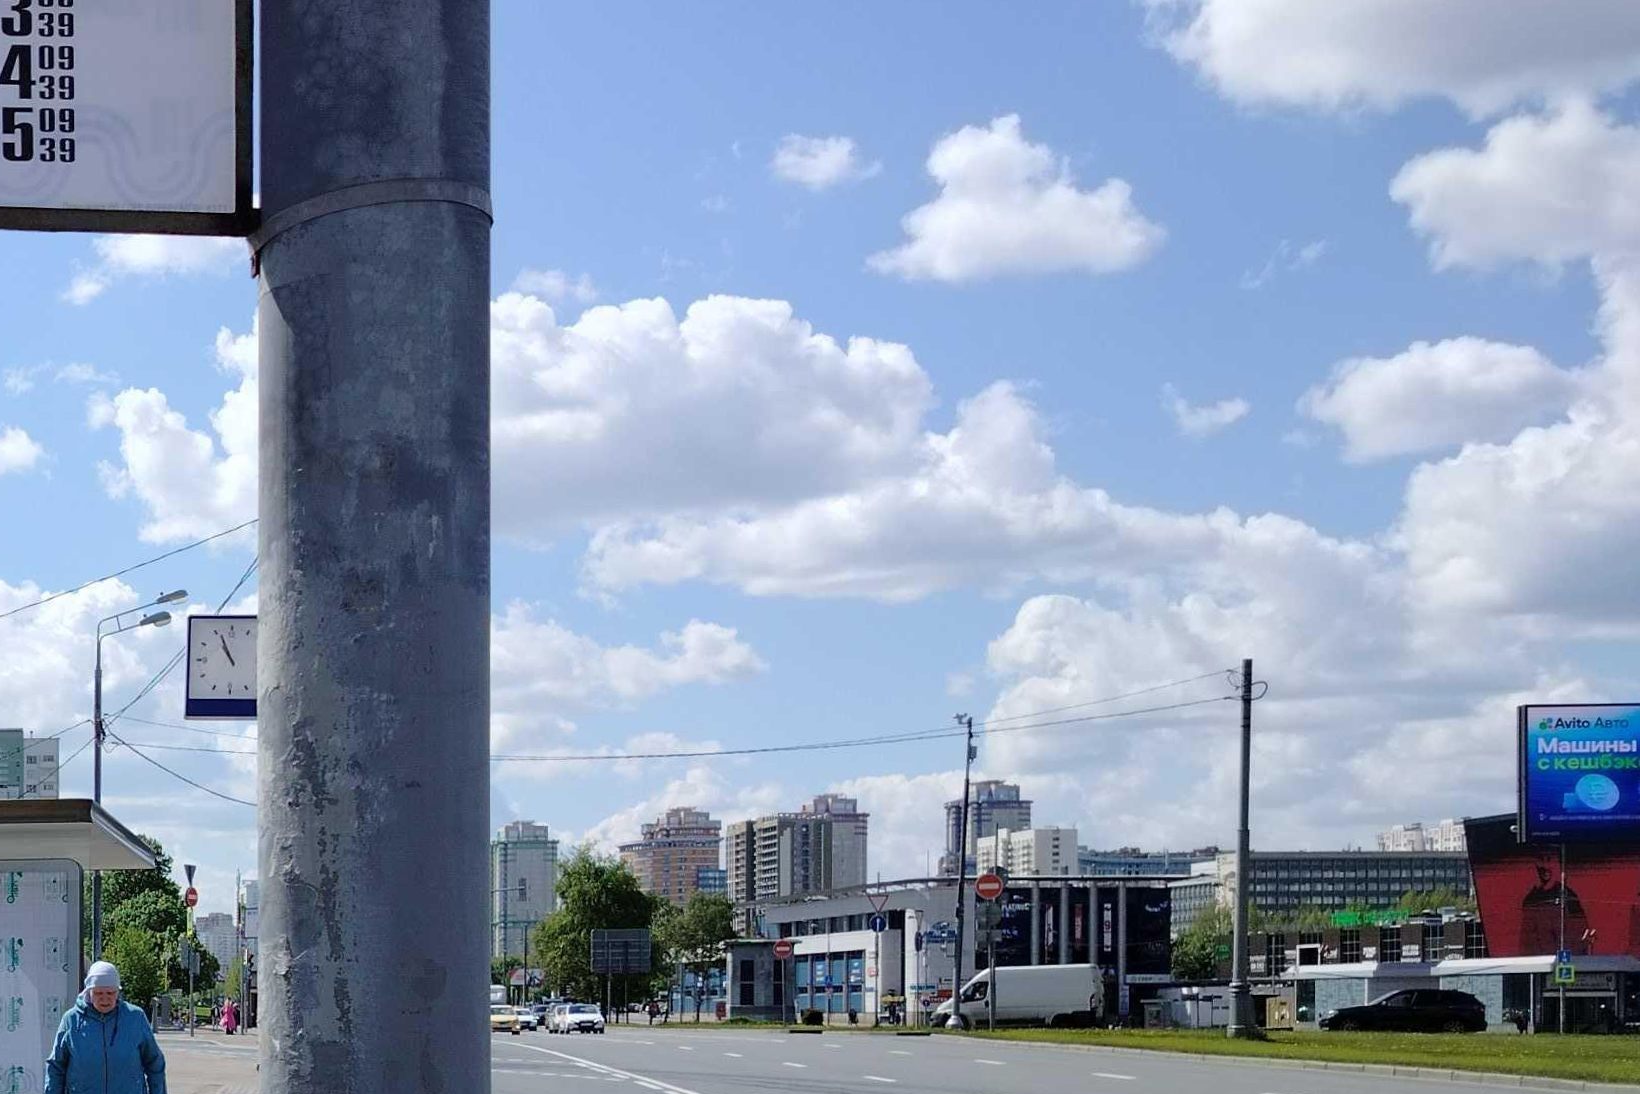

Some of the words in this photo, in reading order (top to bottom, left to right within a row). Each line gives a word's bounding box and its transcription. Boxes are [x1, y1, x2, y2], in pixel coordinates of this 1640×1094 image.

[1, 0, 33, 36] 3
[38, 12, 74, 37] 39
[38, 45, 74, 70] 09
[39, 75, 75, 100] 39
[39, 107, 75, 133] 09
[2, 107, 34, 162] 5
[39, 138, 75, 163] 39
[1555, 717, 1591, 729] Avito
[1594, 717, 1630, 729] Авто
[1537, 737, 1637, 754] Машины
[1554, 754, 1640, 770] кешбэк
